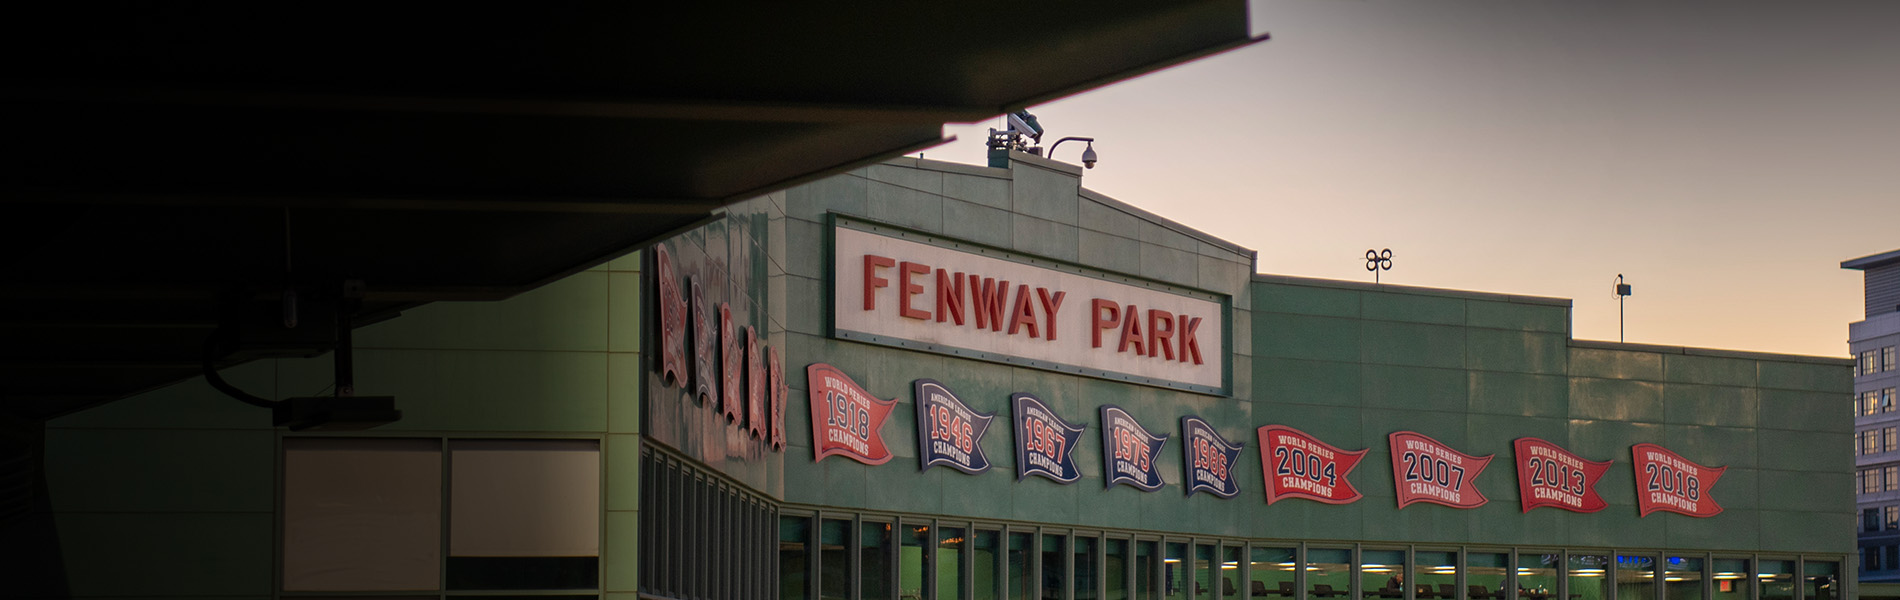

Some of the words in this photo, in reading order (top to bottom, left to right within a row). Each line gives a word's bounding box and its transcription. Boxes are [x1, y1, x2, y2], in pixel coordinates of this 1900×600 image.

[864, 254, 1066, 341] FENWAY
[1092, 298, 1203, 365] PARK
[824, 376, 848, 394] WORLD
[849, 388, 870, 410] SERIES
[826, 390, 869, 441] 1918
[931, 393, 954, 410] AMERICAN
[955, 404, 971, 422] LEAGUE
[1027, 406, 1048, 422] AMERICAN
[828, 429, 868, 456] CHAMPIONS
[930, 404, 973, 454] 1946
[1026, 417, 1066, 464] 1967
[933, 441, 970, 466] CHAMPIONS
[1114, 426, 1150, 473] 1975
[1194, 437, 1227, 481] 1986
[1278, 435, 1306, 449] WORLD
[1308, 442, 1334, 460] SERIES
[1406, 440, 1434, 454] WORLD
[1435, 447, 1462, 465] SERIES
[1530, 446, 1557, 459] WORLD
[1558, 453, 1584, 470] SERIES
[1029, 452, 1063, 477] CHAMPIONS
[1117, 461, 1148, 484] CHAMPIONS
[1275, 445, 1337, 487] 2004
[1403, 451, 1464, 492] 2007
[1529, 456, 1586, 496] 2013
[1646, 452, 1672, 465] WORLD
[1673, 458, 1697, 476] SERIES
[1282, 477, 1333, 497] CHAMPIONS
[1410, 483, 1461, 503] CHAMPIONS
[1645, 462, 1700, 502] 2018
[1534, 487, 1582, 508] CHAMPIONS
[1651, 492, 1697, 512] CHAMPIONS
